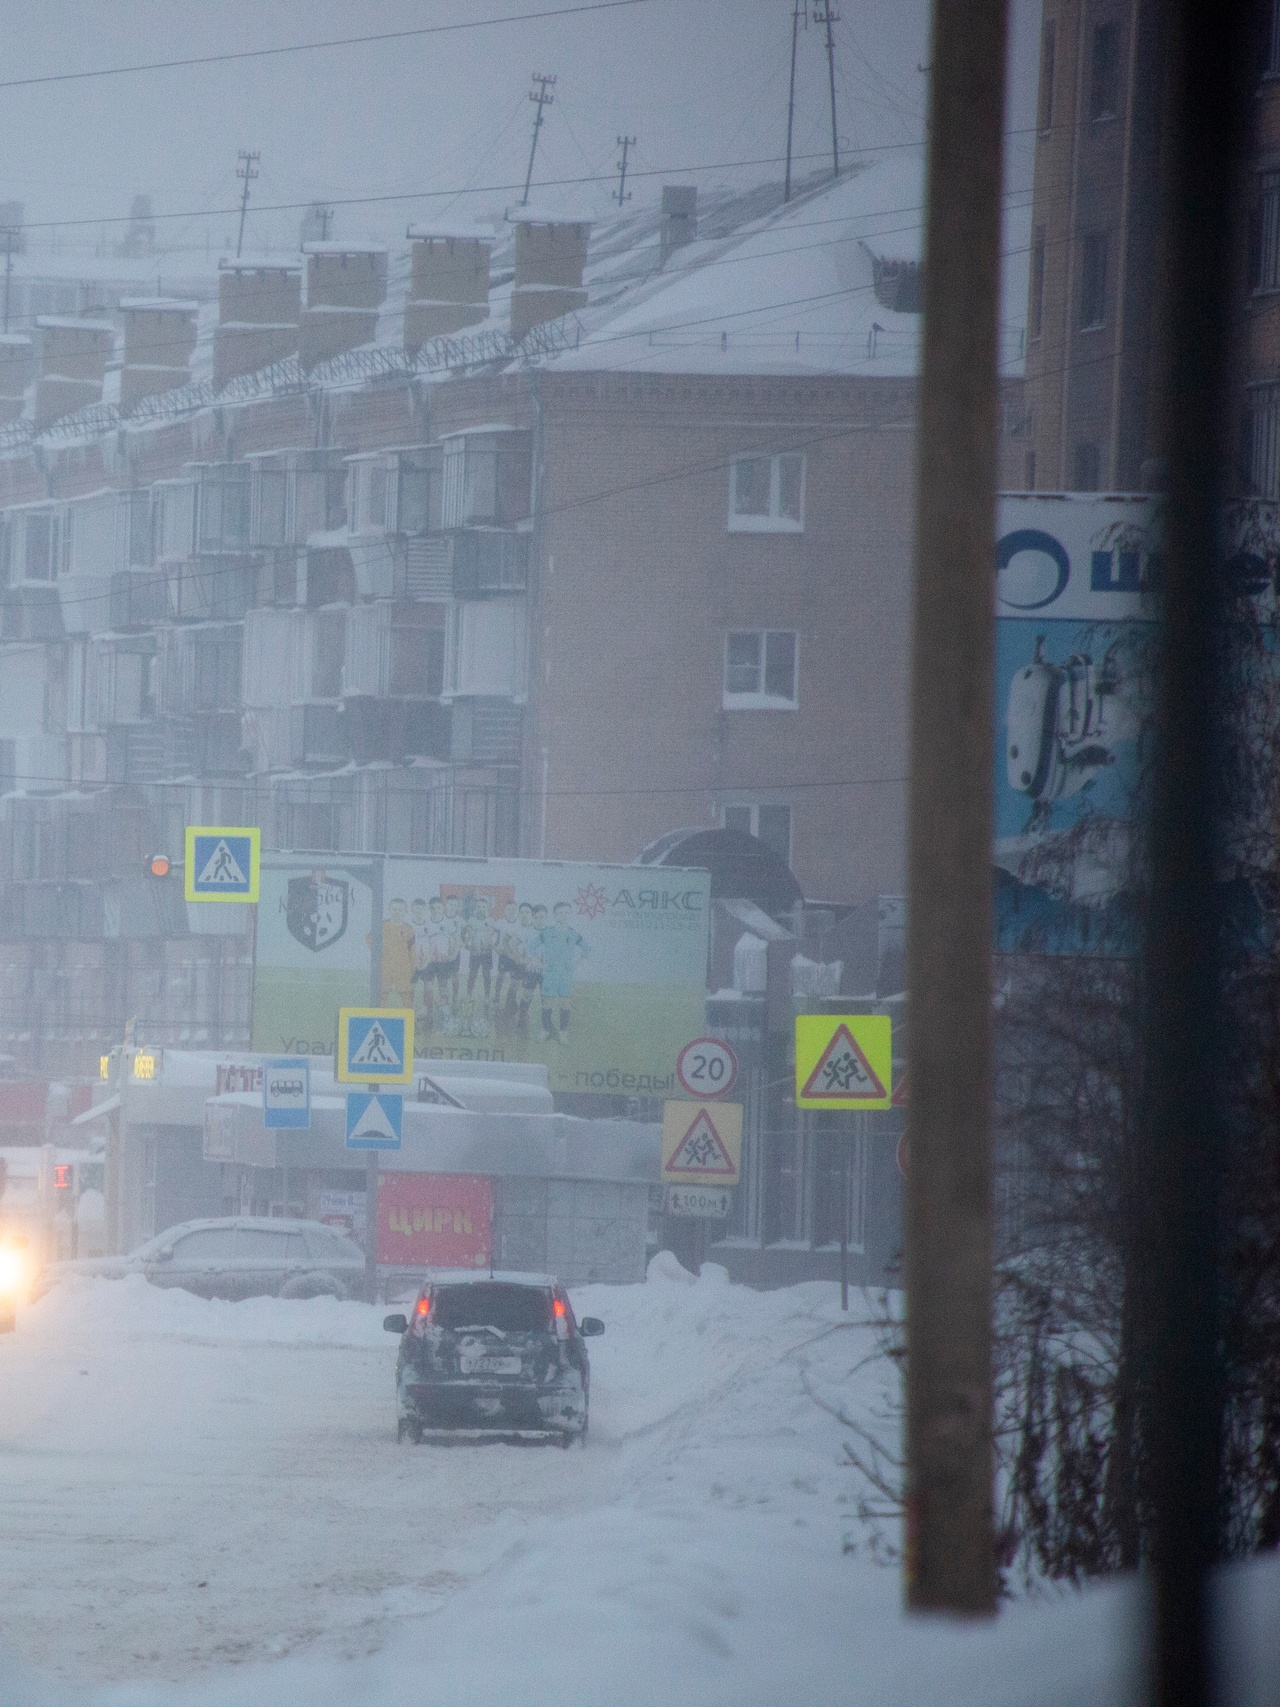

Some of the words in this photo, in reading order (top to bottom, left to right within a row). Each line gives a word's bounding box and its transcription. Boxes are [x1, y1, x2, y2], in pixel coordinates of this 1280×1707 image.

[611, 888, 703, 911] АЯКС
[575, 1068, 676, 1093] победы!
[691, 1054, 725, 1082] 20
[388, 1206, 473, 1236] ЦИРК
